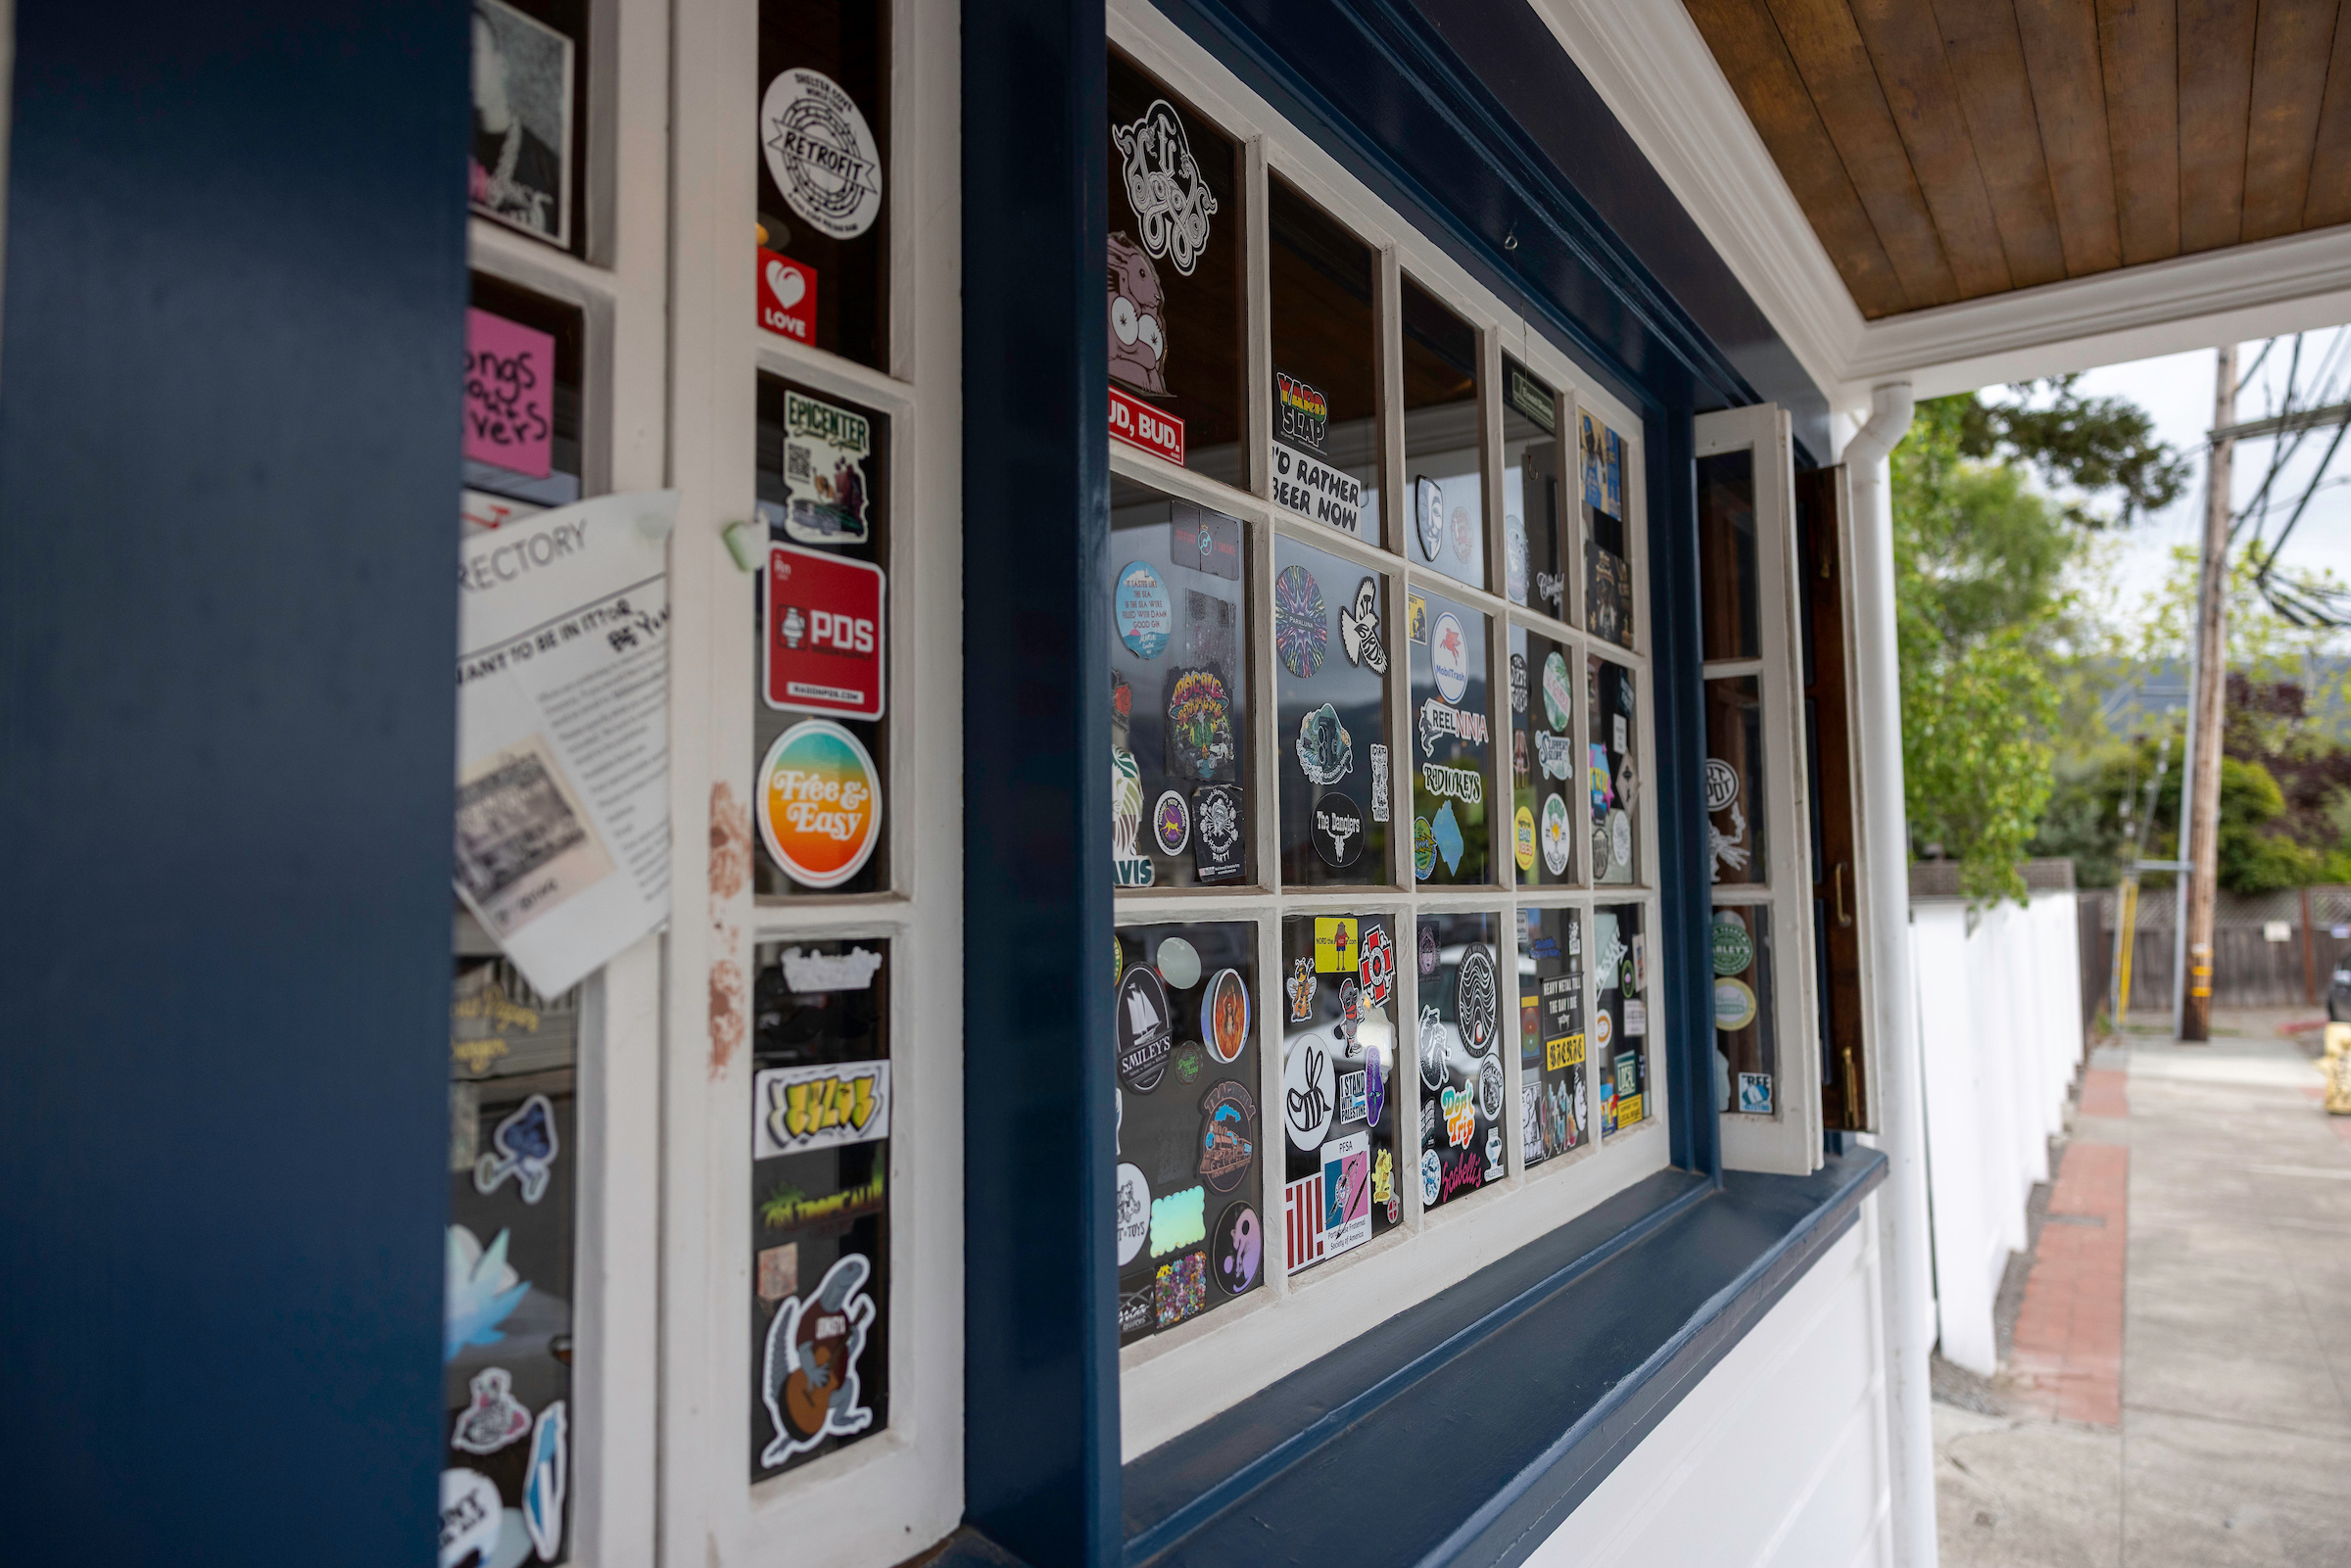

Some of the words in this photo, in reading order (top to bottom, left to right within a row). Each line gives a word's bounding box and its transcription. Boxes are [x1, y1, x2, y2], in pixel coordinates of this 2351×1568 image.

[785, 131, 863, 180] RETROFIT
[765, 309, 806, 338] LOVE
[1276, 371, 1327, 422] YARD
[789, 396, 867, 450] EPICENTER
[1108, 400, 1135, 438] UD,
[1138, 412, 1180, 453] BUD.
[1282, 404, 1325, 448] SLAP
[1296, 458, 1359, 508] RATHER
[1318, 496, 1357, 533] NOW
[1131, 580, 1148, 589] TASTES
[810, 609, 875, 653] PDS
[1132, 620, 1150, 629] GOOD
[1289, 616, 1314, 629] PARALUNA
[1436, 664, 1465, 682] MobilTrash
[1175, 673, 1223, 706] ROGUE
[1432, 709, 1456, 731] REEL
[1456, 711, 1488, 742] NINJA
[840, 781, 870, 811] &
[1424, 766, 1480, 801] RADIOKEYS
[786, 801, 863, 842] Easy
[1316, 810, 1330, 831] The
[1331, 812, 1361, 833] Danglers
[1518, 827, 1532, 843] BAD
[1212, 849, 1230, 863] PARTY
[1516, 841, 1533, 857] VIBES
[1122, 1035, 1172, 1074] SMILEY'S
[1340, 1076, 1344, 1098] I
[1344, 1071, 1366, 1097] STAND
[1442, 1082, 1474, 1117] Don't
[1341, 1103, 1367, 1122] PALESTINE
[1448, 1113, 1474, 1146] Trip
[1338, 1140, 1354, 1155] PFSA
[1485, 1165, 1505, 1180] PALESTINE
[1128, 1220, 1145, 1238] TOYS
[1330, 1237, 1345, 1252] Society
[1349, 1230, 1365, 1243] America
